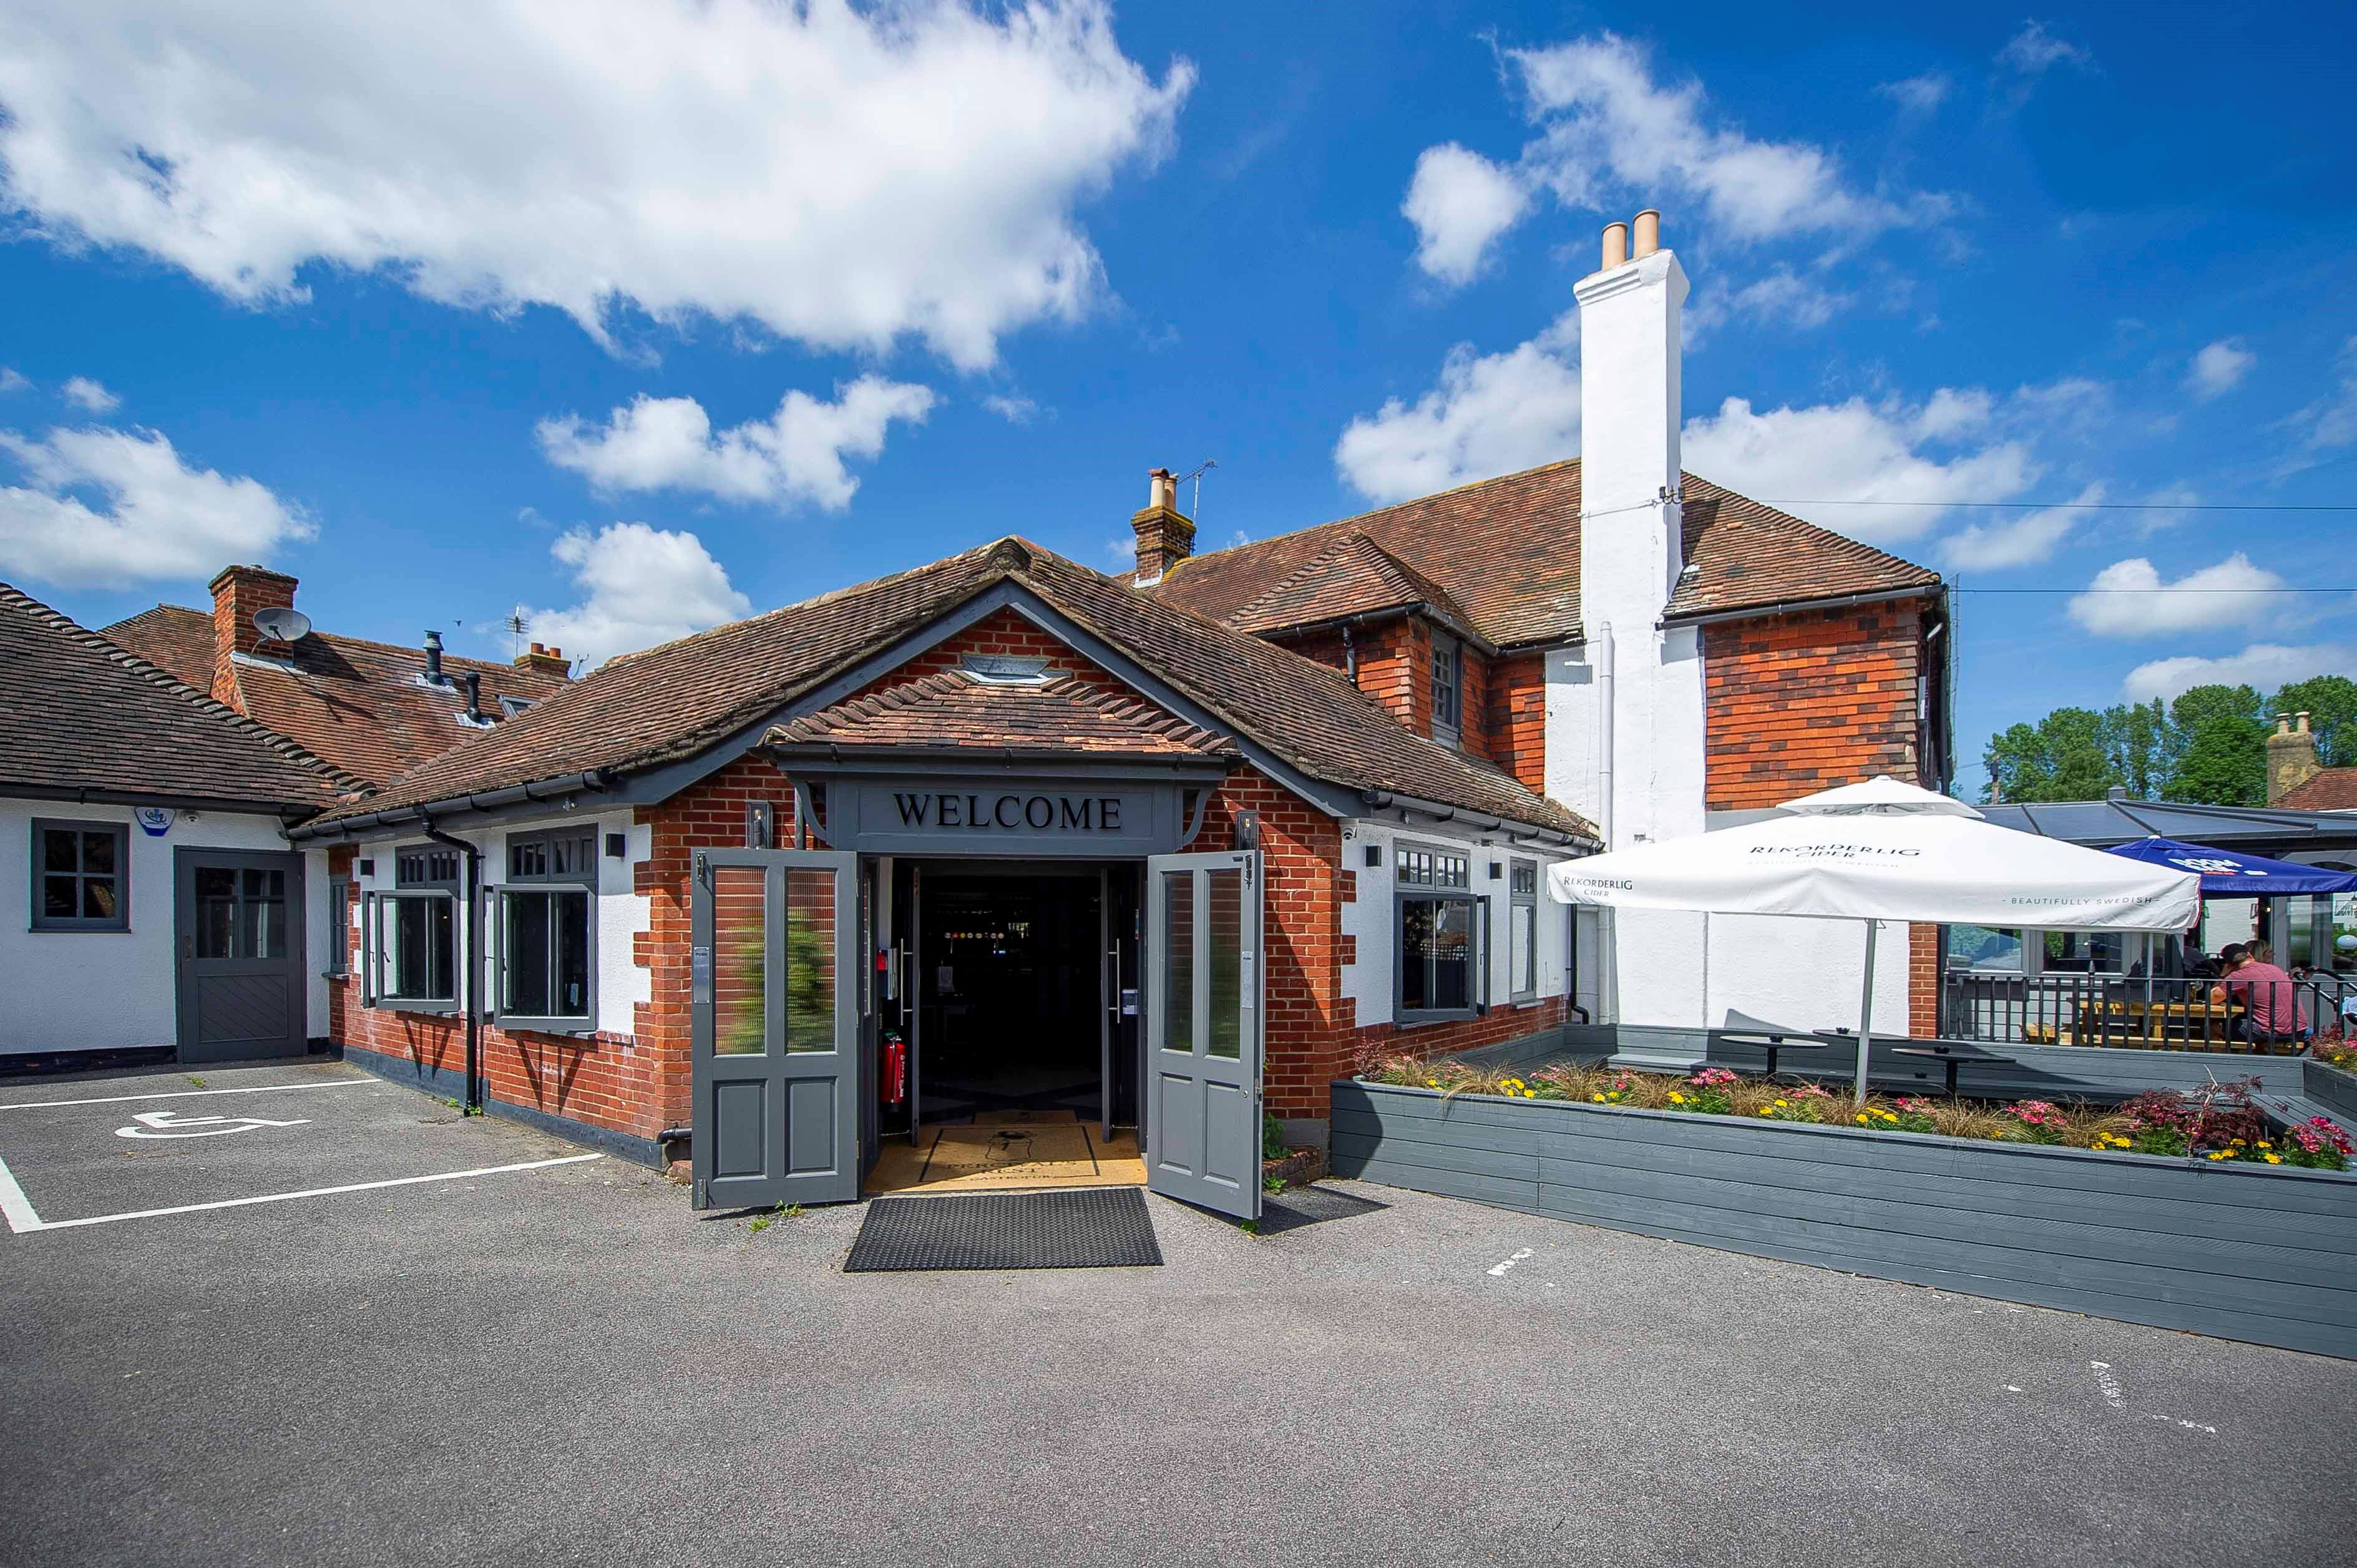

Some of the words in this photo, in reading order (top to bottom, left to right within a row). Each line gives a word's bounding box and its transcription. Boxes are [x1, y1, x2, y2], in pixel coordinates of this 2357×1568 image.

[892, 793, 1122, 829] WELCOME
[1750, 844, 1921, 856] REKORDERLIG
[1564, 876, 1632, 890] REKORDERLIG
[1584, 889, 1609, 897] CIDER
